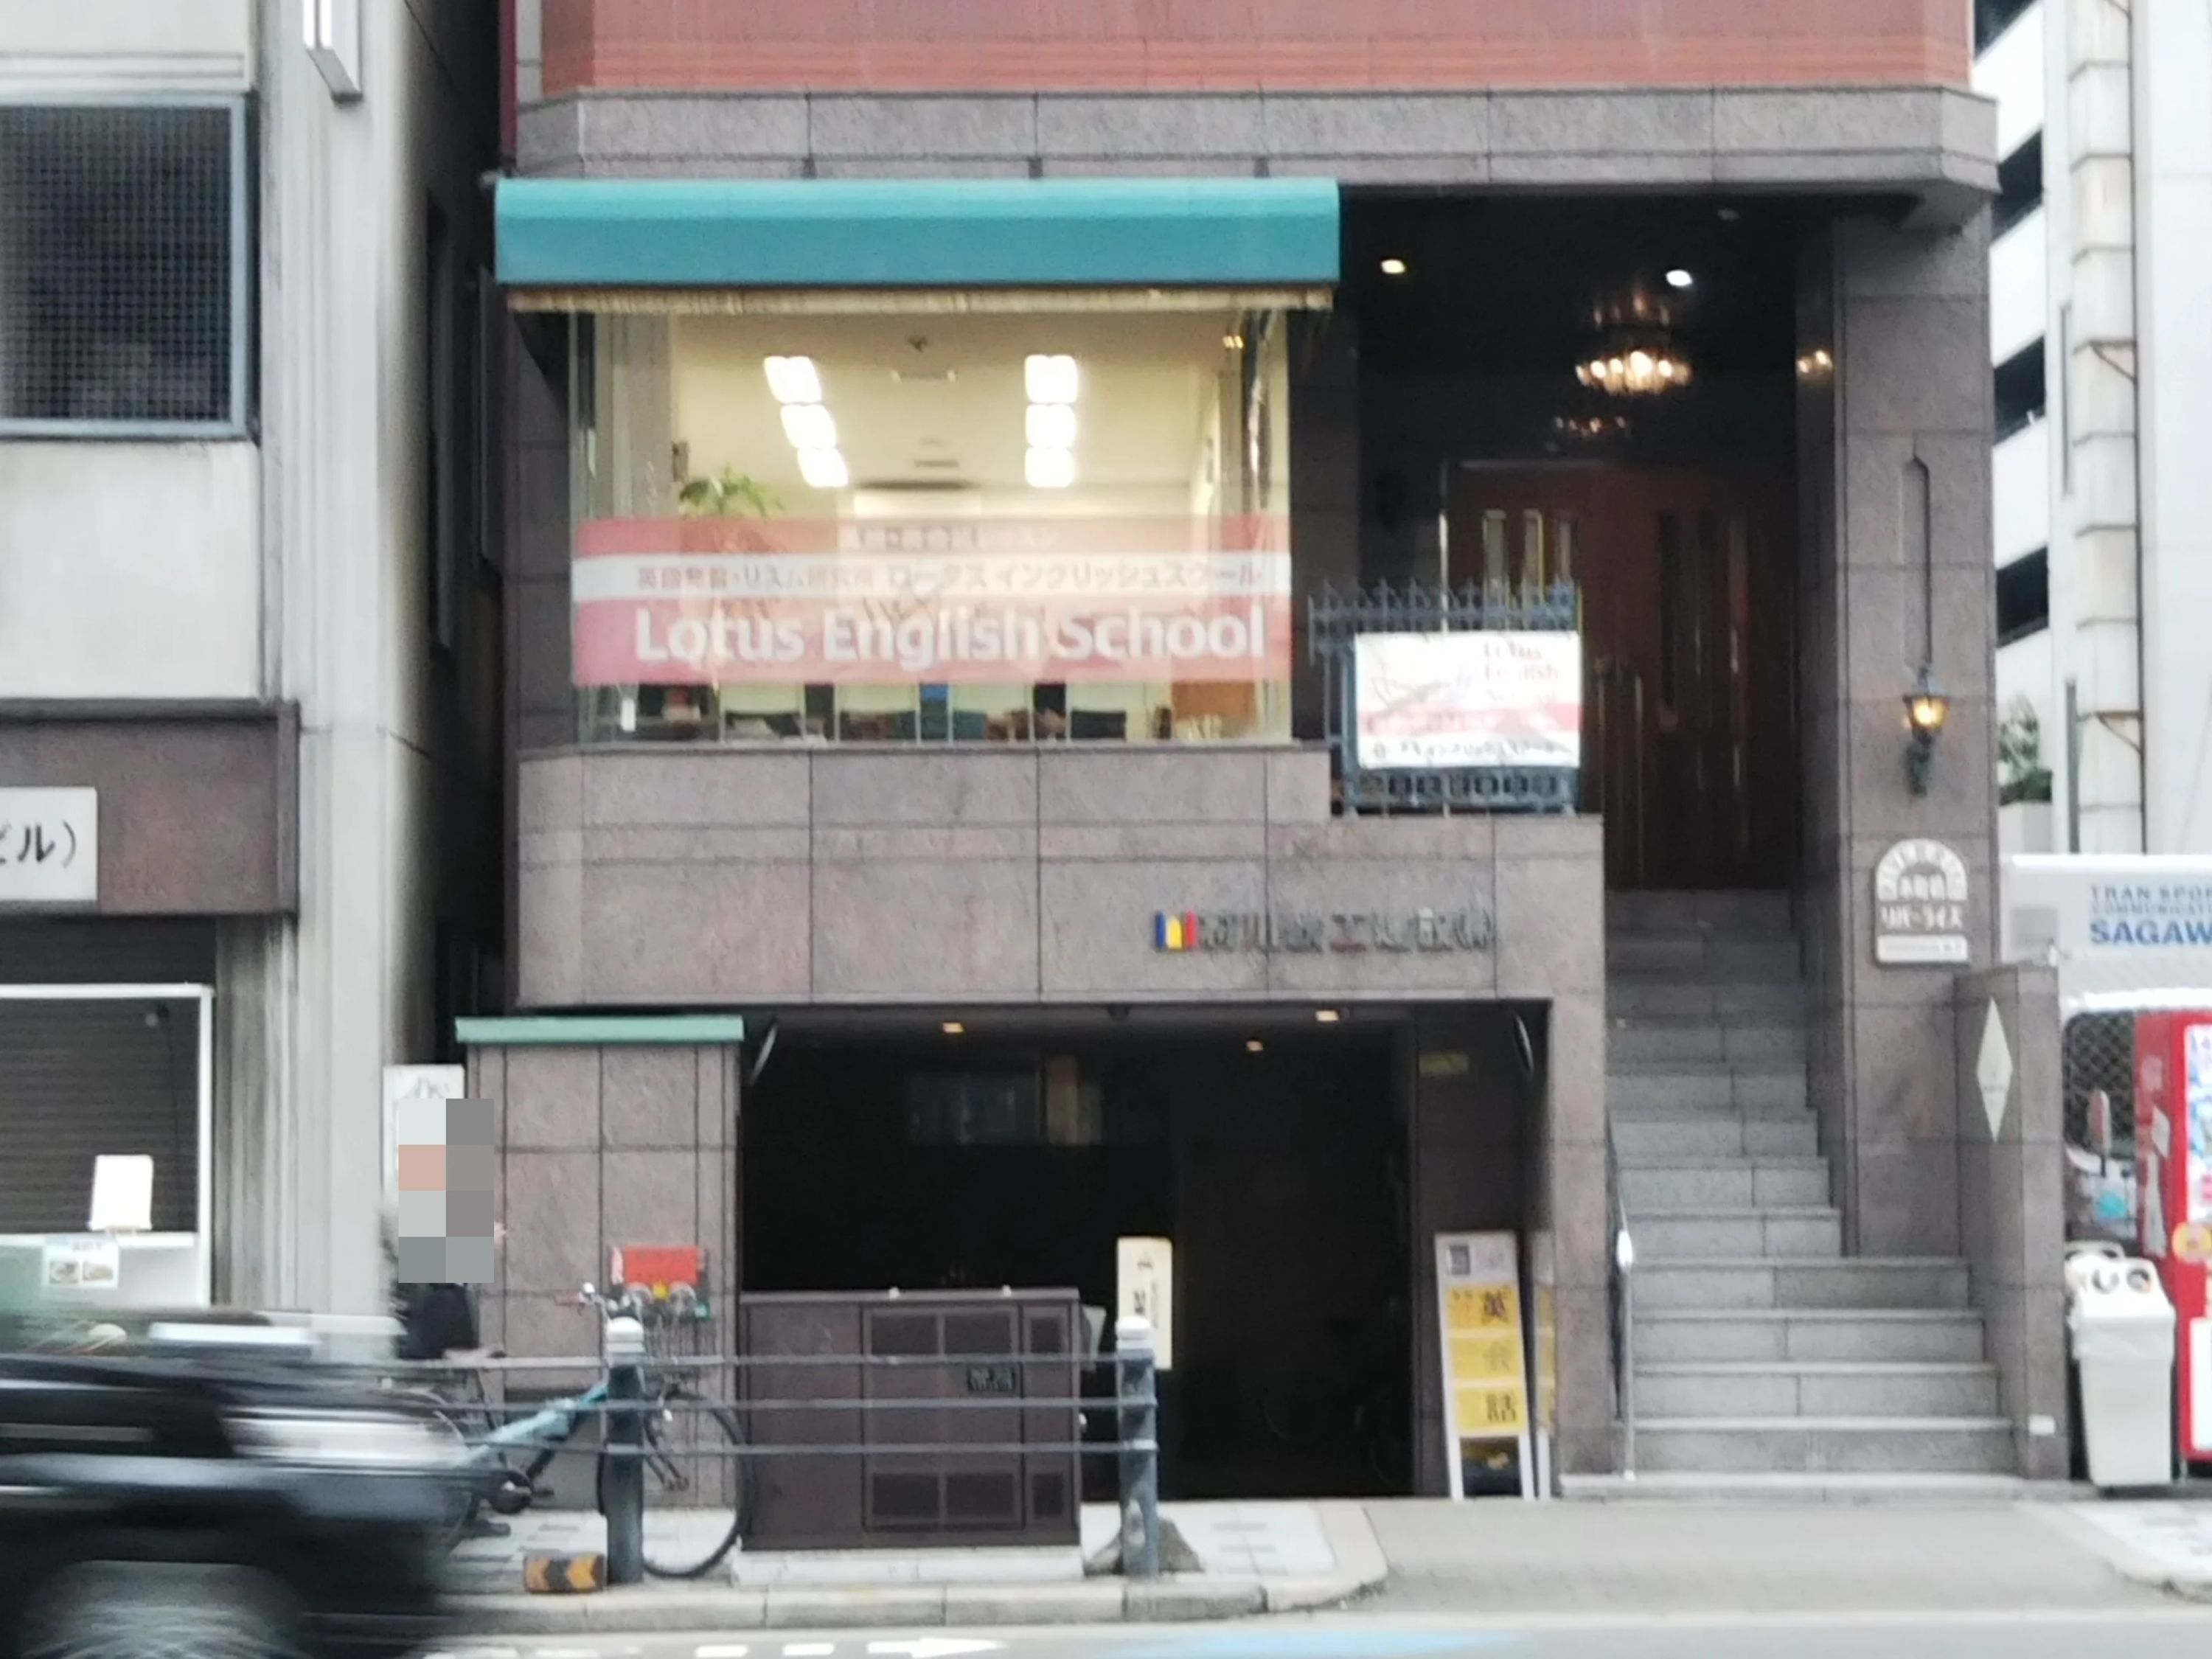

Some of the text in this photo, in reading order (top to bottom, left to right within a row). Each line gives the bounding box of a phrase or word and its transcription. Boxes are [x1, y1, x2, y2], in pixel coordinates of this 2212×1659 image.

[635, 605, 1265, 672] Lotus English School
